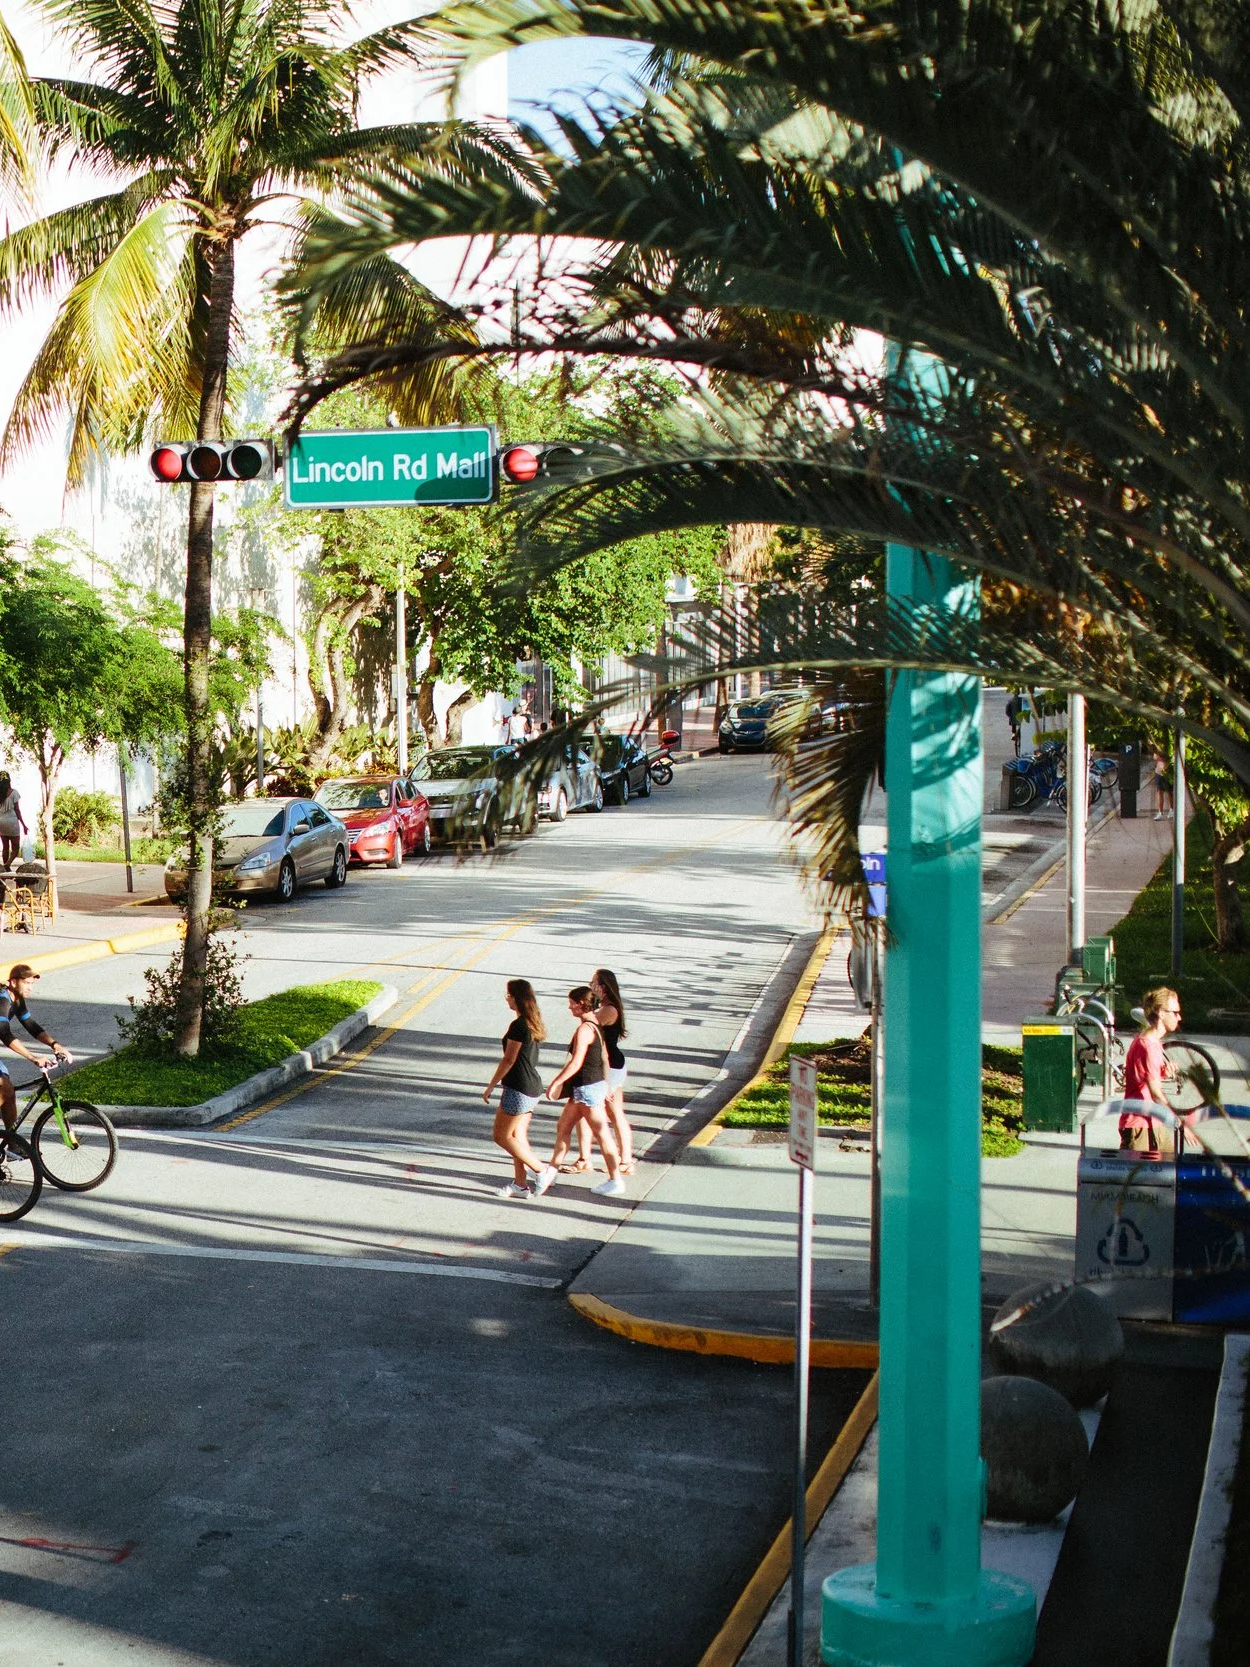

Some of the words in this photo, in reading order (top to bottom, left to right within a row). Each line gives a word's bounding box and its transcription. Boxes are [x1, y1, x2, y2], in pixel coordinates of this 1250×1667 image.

[292, 455, 383, 484] Lincoln
[393, 453, 427, 480] Rd
[437, 451, 486, 479] Mall
